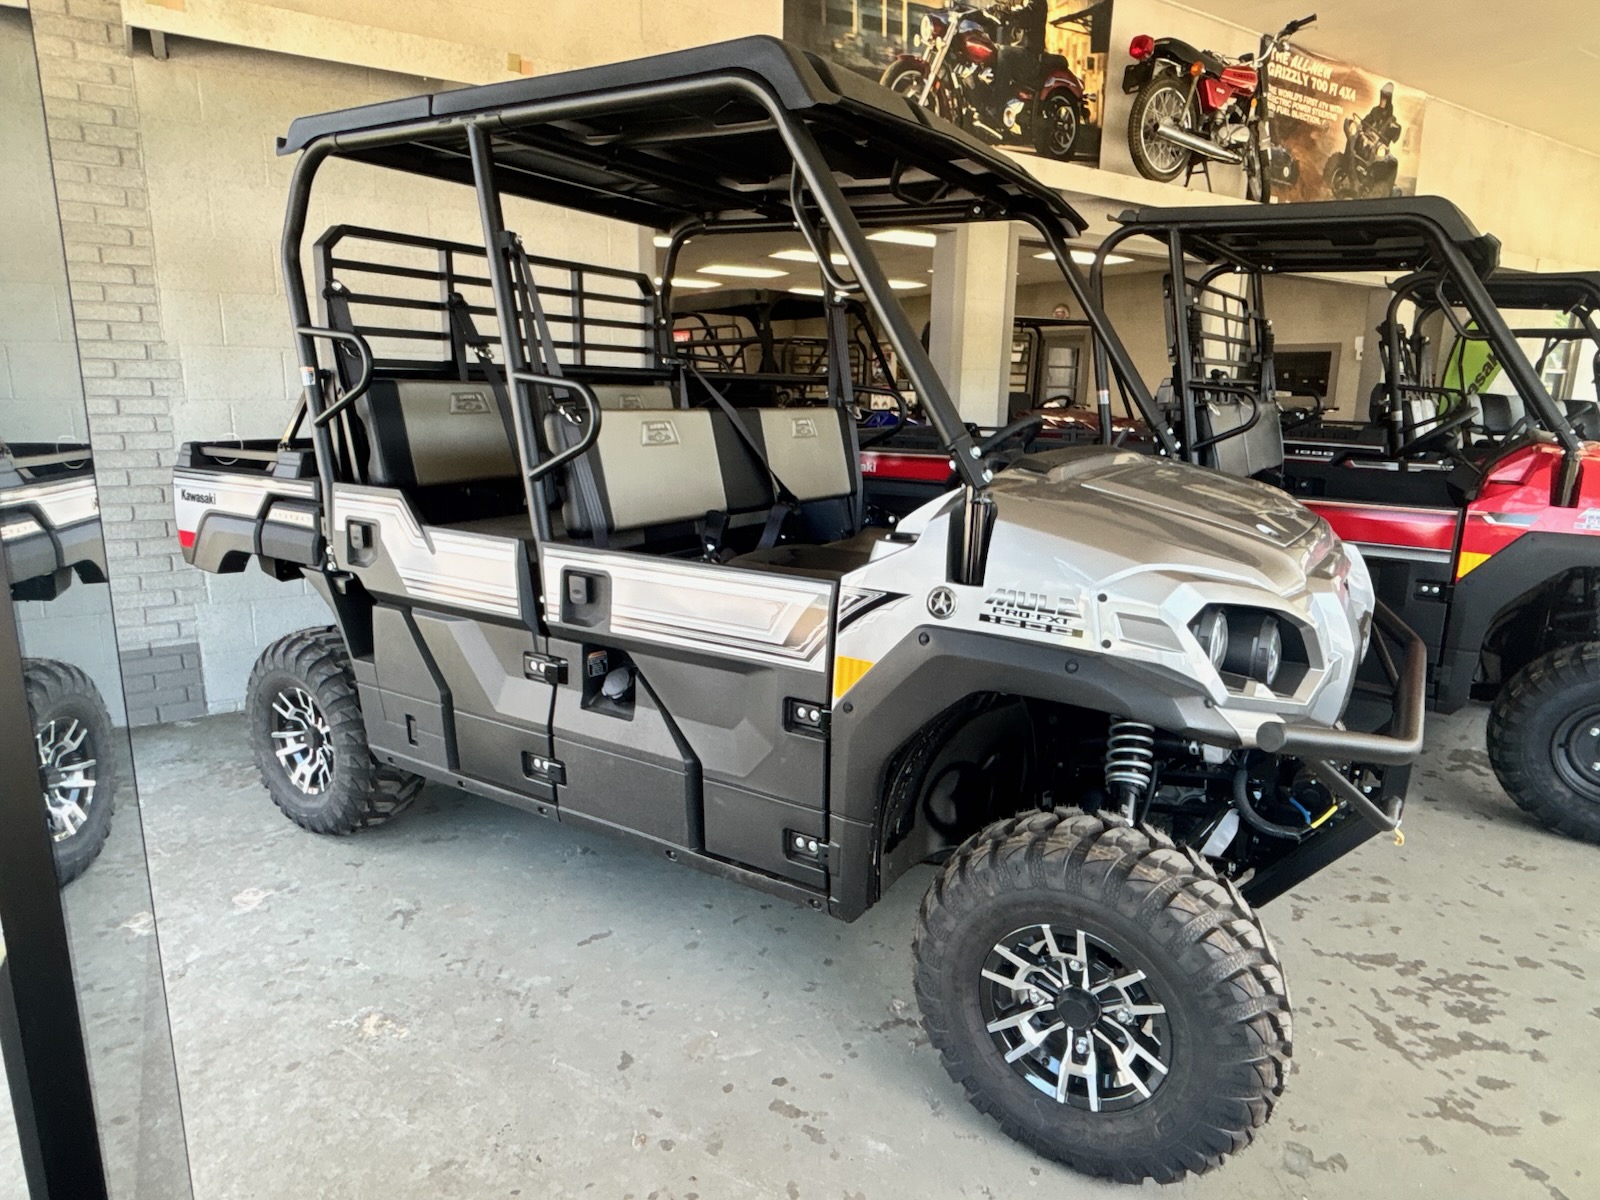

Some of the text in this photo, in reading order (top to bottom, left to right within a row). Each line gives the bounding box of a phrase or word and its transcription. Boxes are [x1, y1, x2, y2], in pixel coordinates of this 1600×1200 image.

[1271, 47, 1334, 79] THE ALL-NEW
[1267, 61, 1309, 87] GRIZZLY
[1311, 77, 1329, 93] 700
[1329, 82, 1338, 97] FI
[1338, 86, 1357, 102] 4X4
[1276, 105, 1291, 117] FUEL
[1291, 101, 1312, 113] POWER
[1311, 107, 1338, 121] STEERING
[1303, 95, 1319, 107] FIRST
[1329, 104, 1344, 114] WITH
[181, 488, 216, 505] Kawasaki
[984, 588, 1082, 619] MULE
[992, 606, 1072, 625] PRO-FXT
